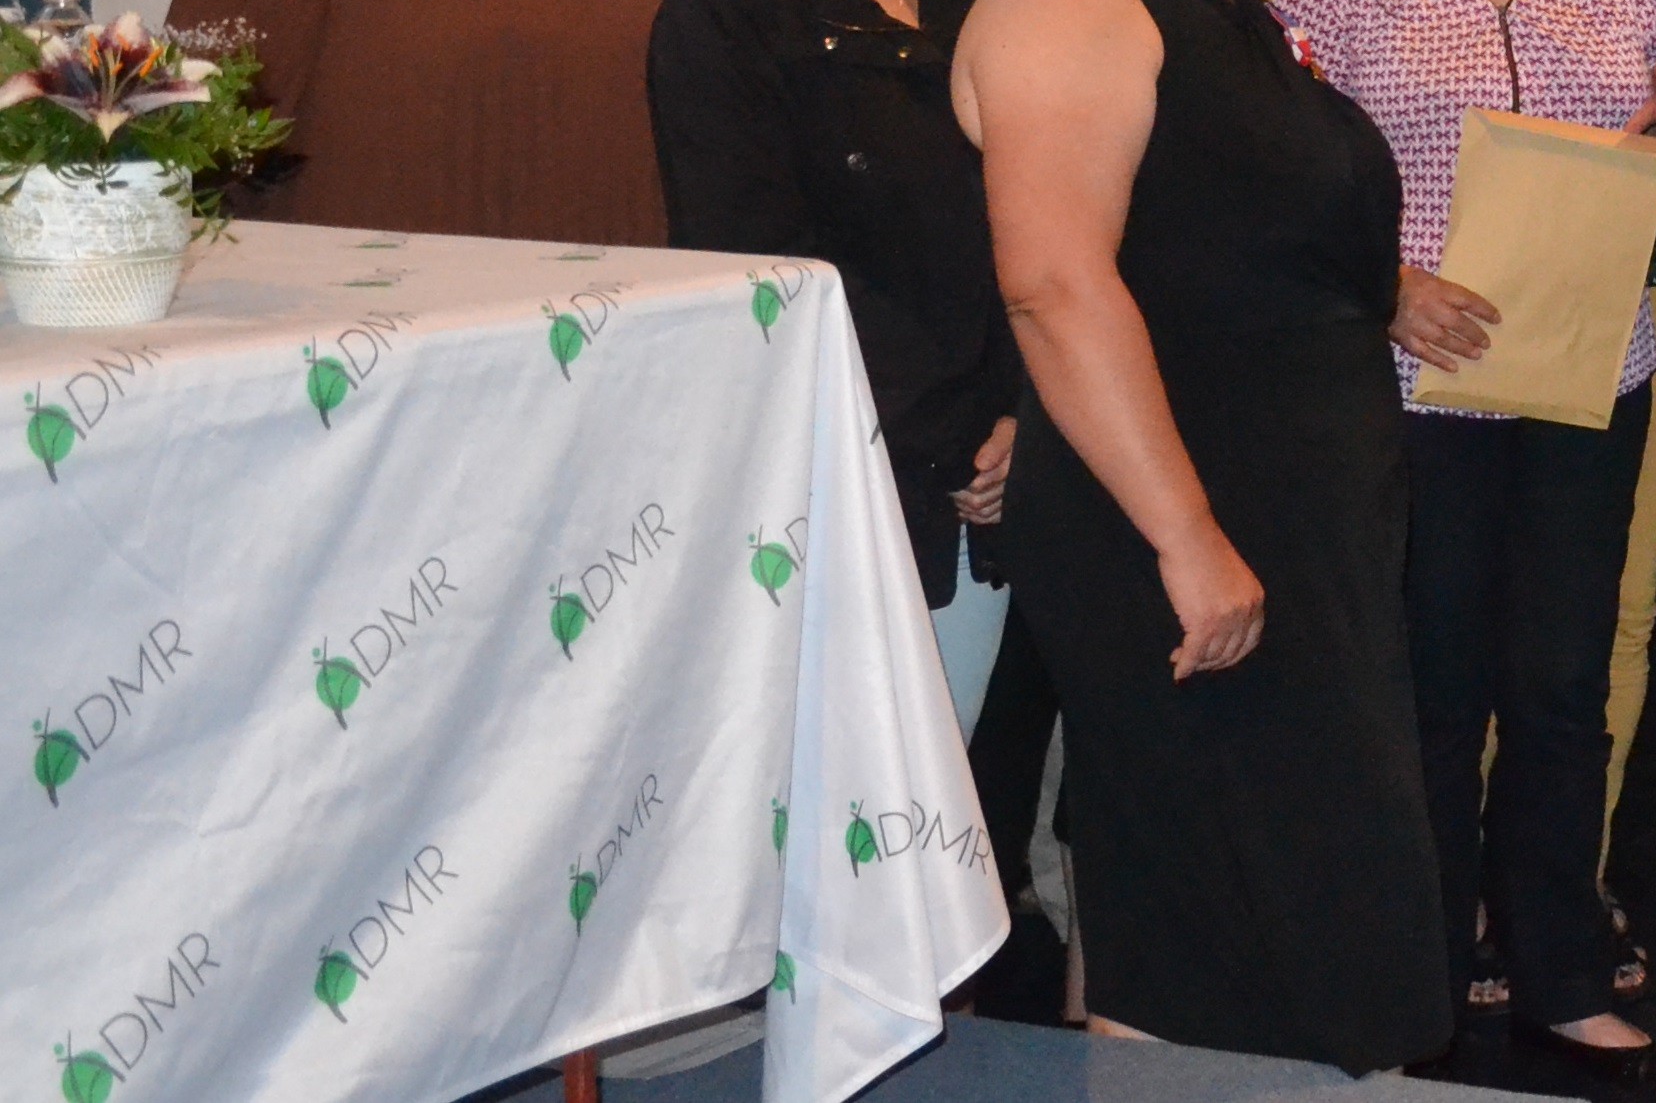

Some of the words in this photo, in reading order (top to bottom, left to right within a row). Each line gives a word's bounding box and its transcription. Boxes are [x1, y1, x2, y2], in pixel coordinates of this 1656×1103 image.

[312, 557, 458, 729] ADMR
[549, 503, 676, 661] ADMR
[33, 619, 193, 808] ADMR
[314, 845, 459, 1024] ADMR
[569, 774, 664, 938] ADMR
[54, 932, 221, 1102] ADMR
